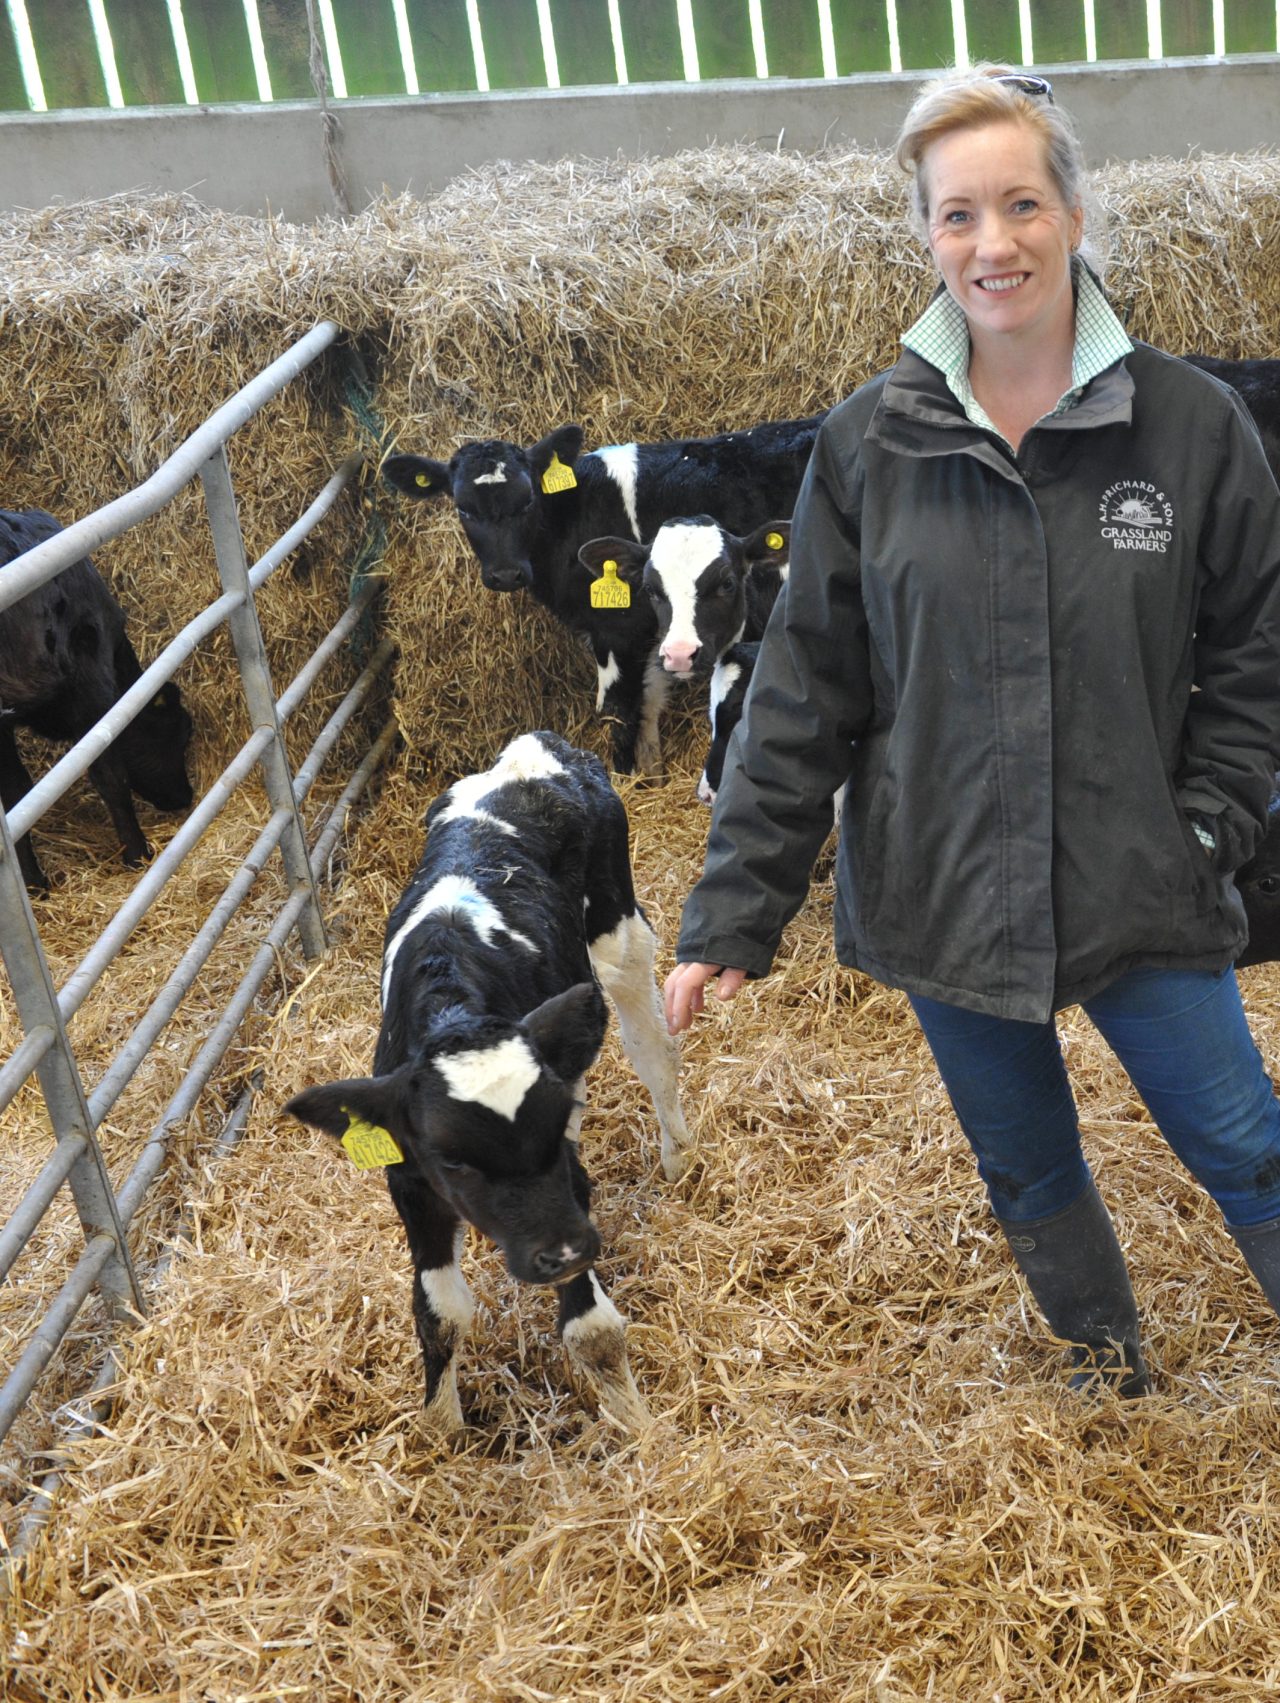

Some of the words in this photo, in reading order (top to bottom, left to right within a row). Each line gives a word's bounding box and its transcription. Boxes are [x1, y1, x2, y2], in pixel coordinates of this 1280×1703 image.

[1156, 492, 1165, 502] &
[1162, 502, 1174, 526] SON
[1101, 527, 1172, 542] GRASSLAND
[1114, 538, 1167, 553] FARMERS
[594, 591, 628, 606] 717426
